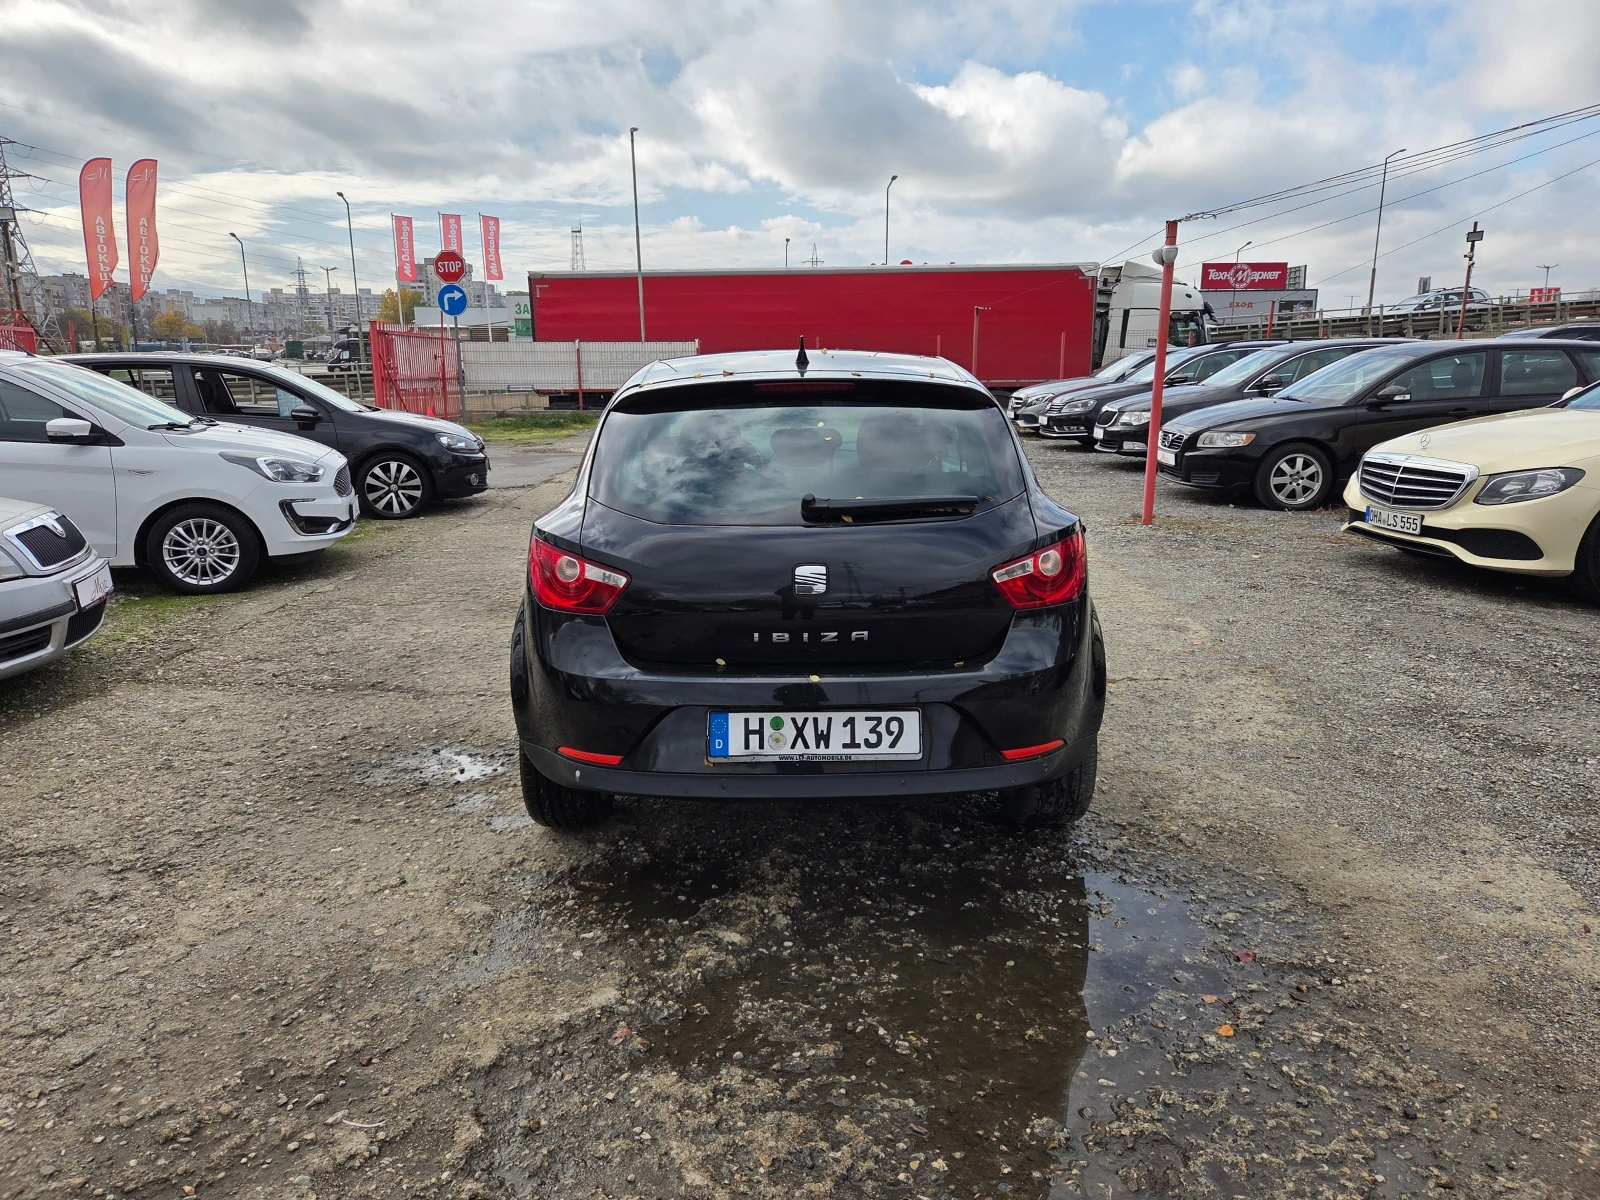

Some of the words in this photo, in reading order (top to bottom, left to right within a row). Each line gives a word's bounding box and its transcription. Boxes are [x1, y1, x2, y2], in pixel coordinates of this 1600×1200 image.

[448, 218, 459, 251] icolage
[437, 261, 462, 273] STOP
[1229, 301, 1253, 309] ВХОД
[1387, 513, 1398, 528] LS
[1400, 516, 1419, 531] 555
[753, 630, 869, 643] IBIZA
[715, 739, 723, 749] D
[743, 717, 765, 750] H
[790, 716, 833, 750] XW
[842, 716, 905, 749] 139
